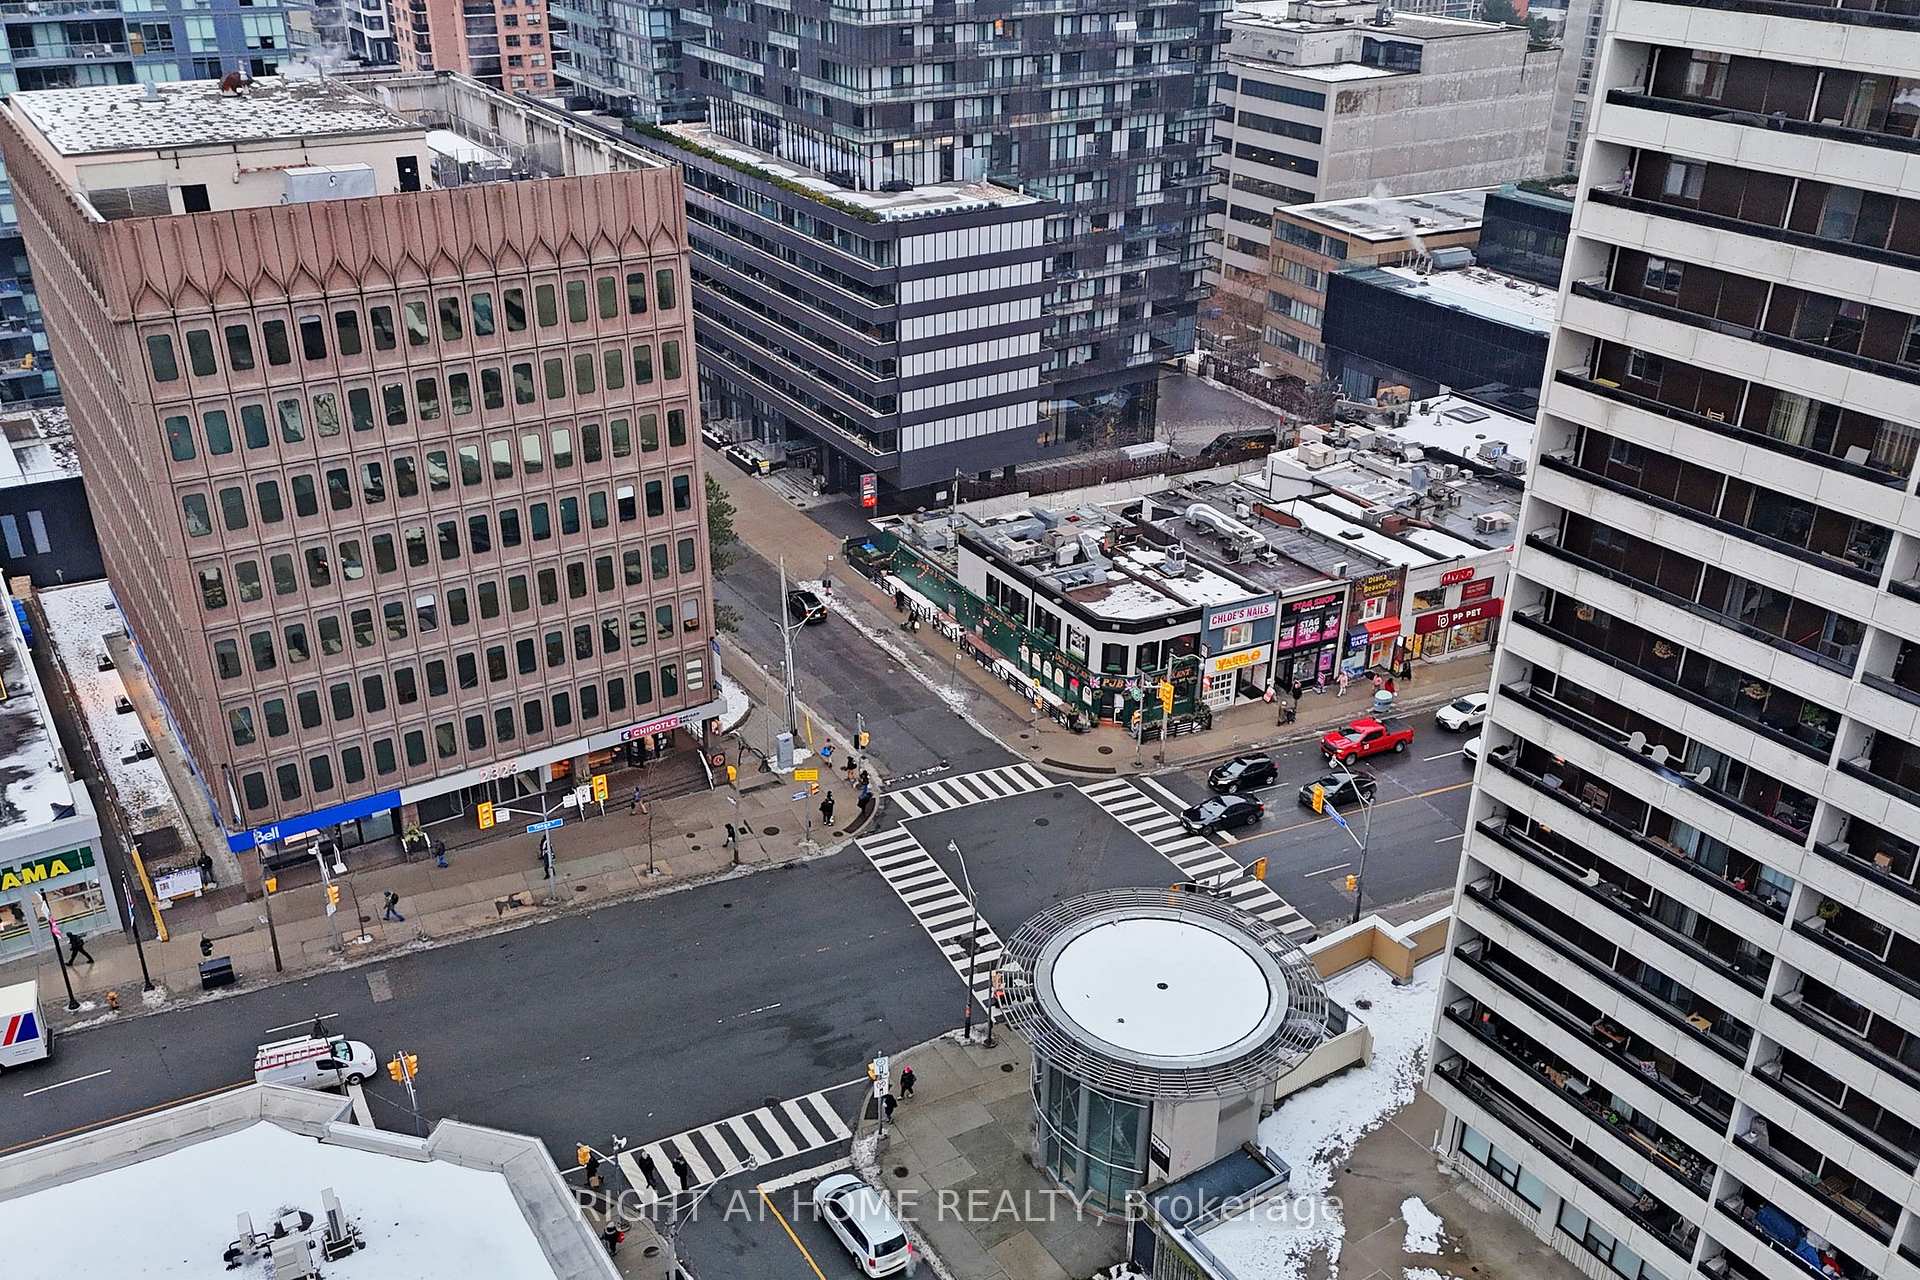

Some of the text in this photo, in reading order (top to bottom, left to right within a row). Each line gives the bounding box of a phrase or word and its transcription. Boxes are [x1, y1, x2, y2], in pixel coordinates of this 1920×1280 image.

[1212, 604, 1270, 625] CHLOE'S NAILS
[1300, 617, 1320, 629] STAG
[1452, 607, 1482, 622] PP PET
[1298, 625, 1320, 637] SHOP
[633, 718, 678, 737] CHIPOTLE
[255, 826, 280, 844] Bell
[1, 859, 70, 891] AMA
